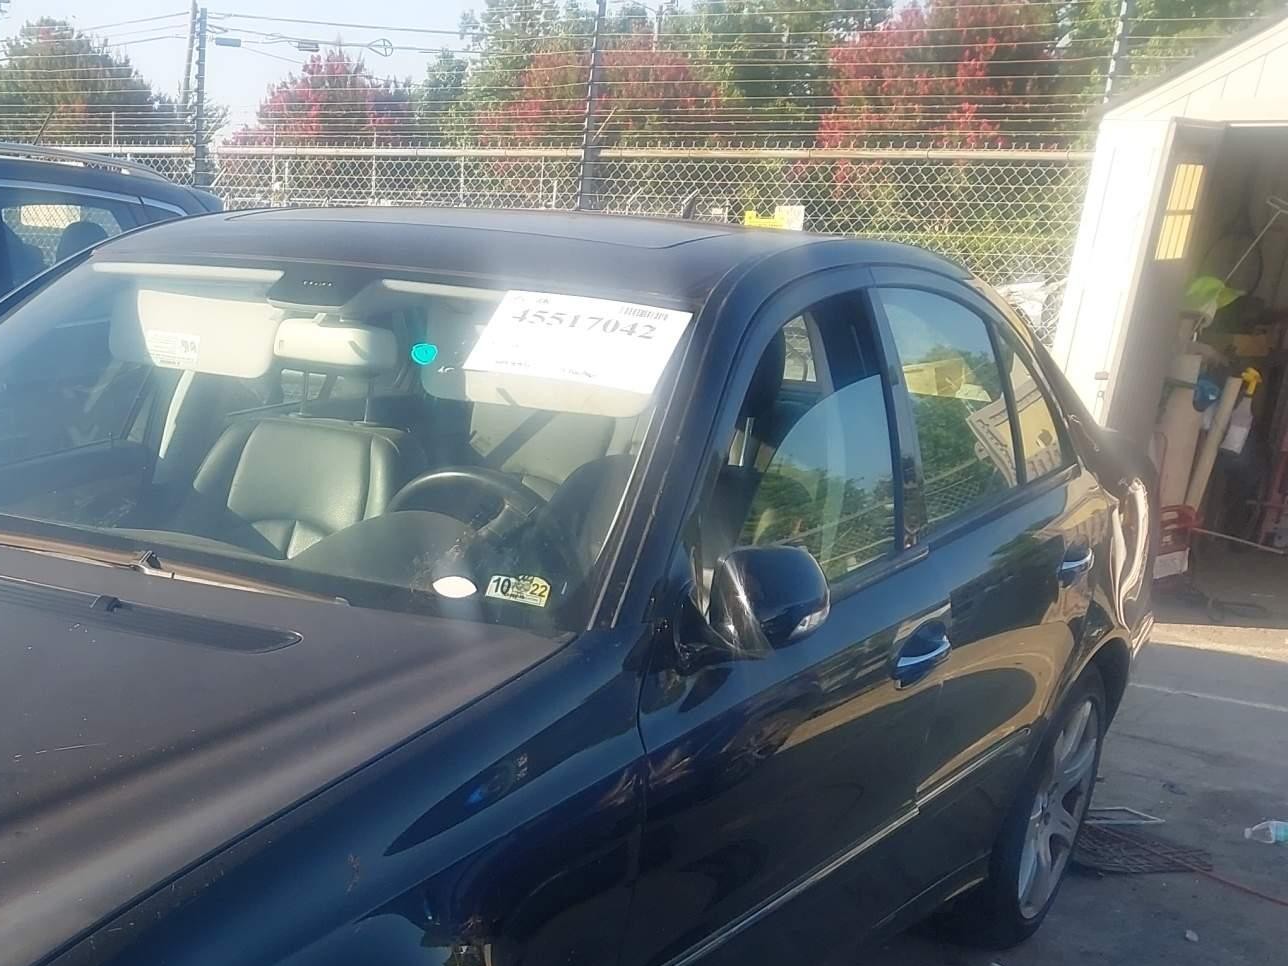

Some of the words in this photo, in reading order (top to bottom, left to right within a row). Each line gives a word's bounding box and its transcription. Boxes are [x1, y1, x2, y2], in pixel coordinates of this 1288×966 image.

[512, 308, 657, 340] 45517042
[493, 577, 512, 595] 10
[530, 583, 548, 598] 22
